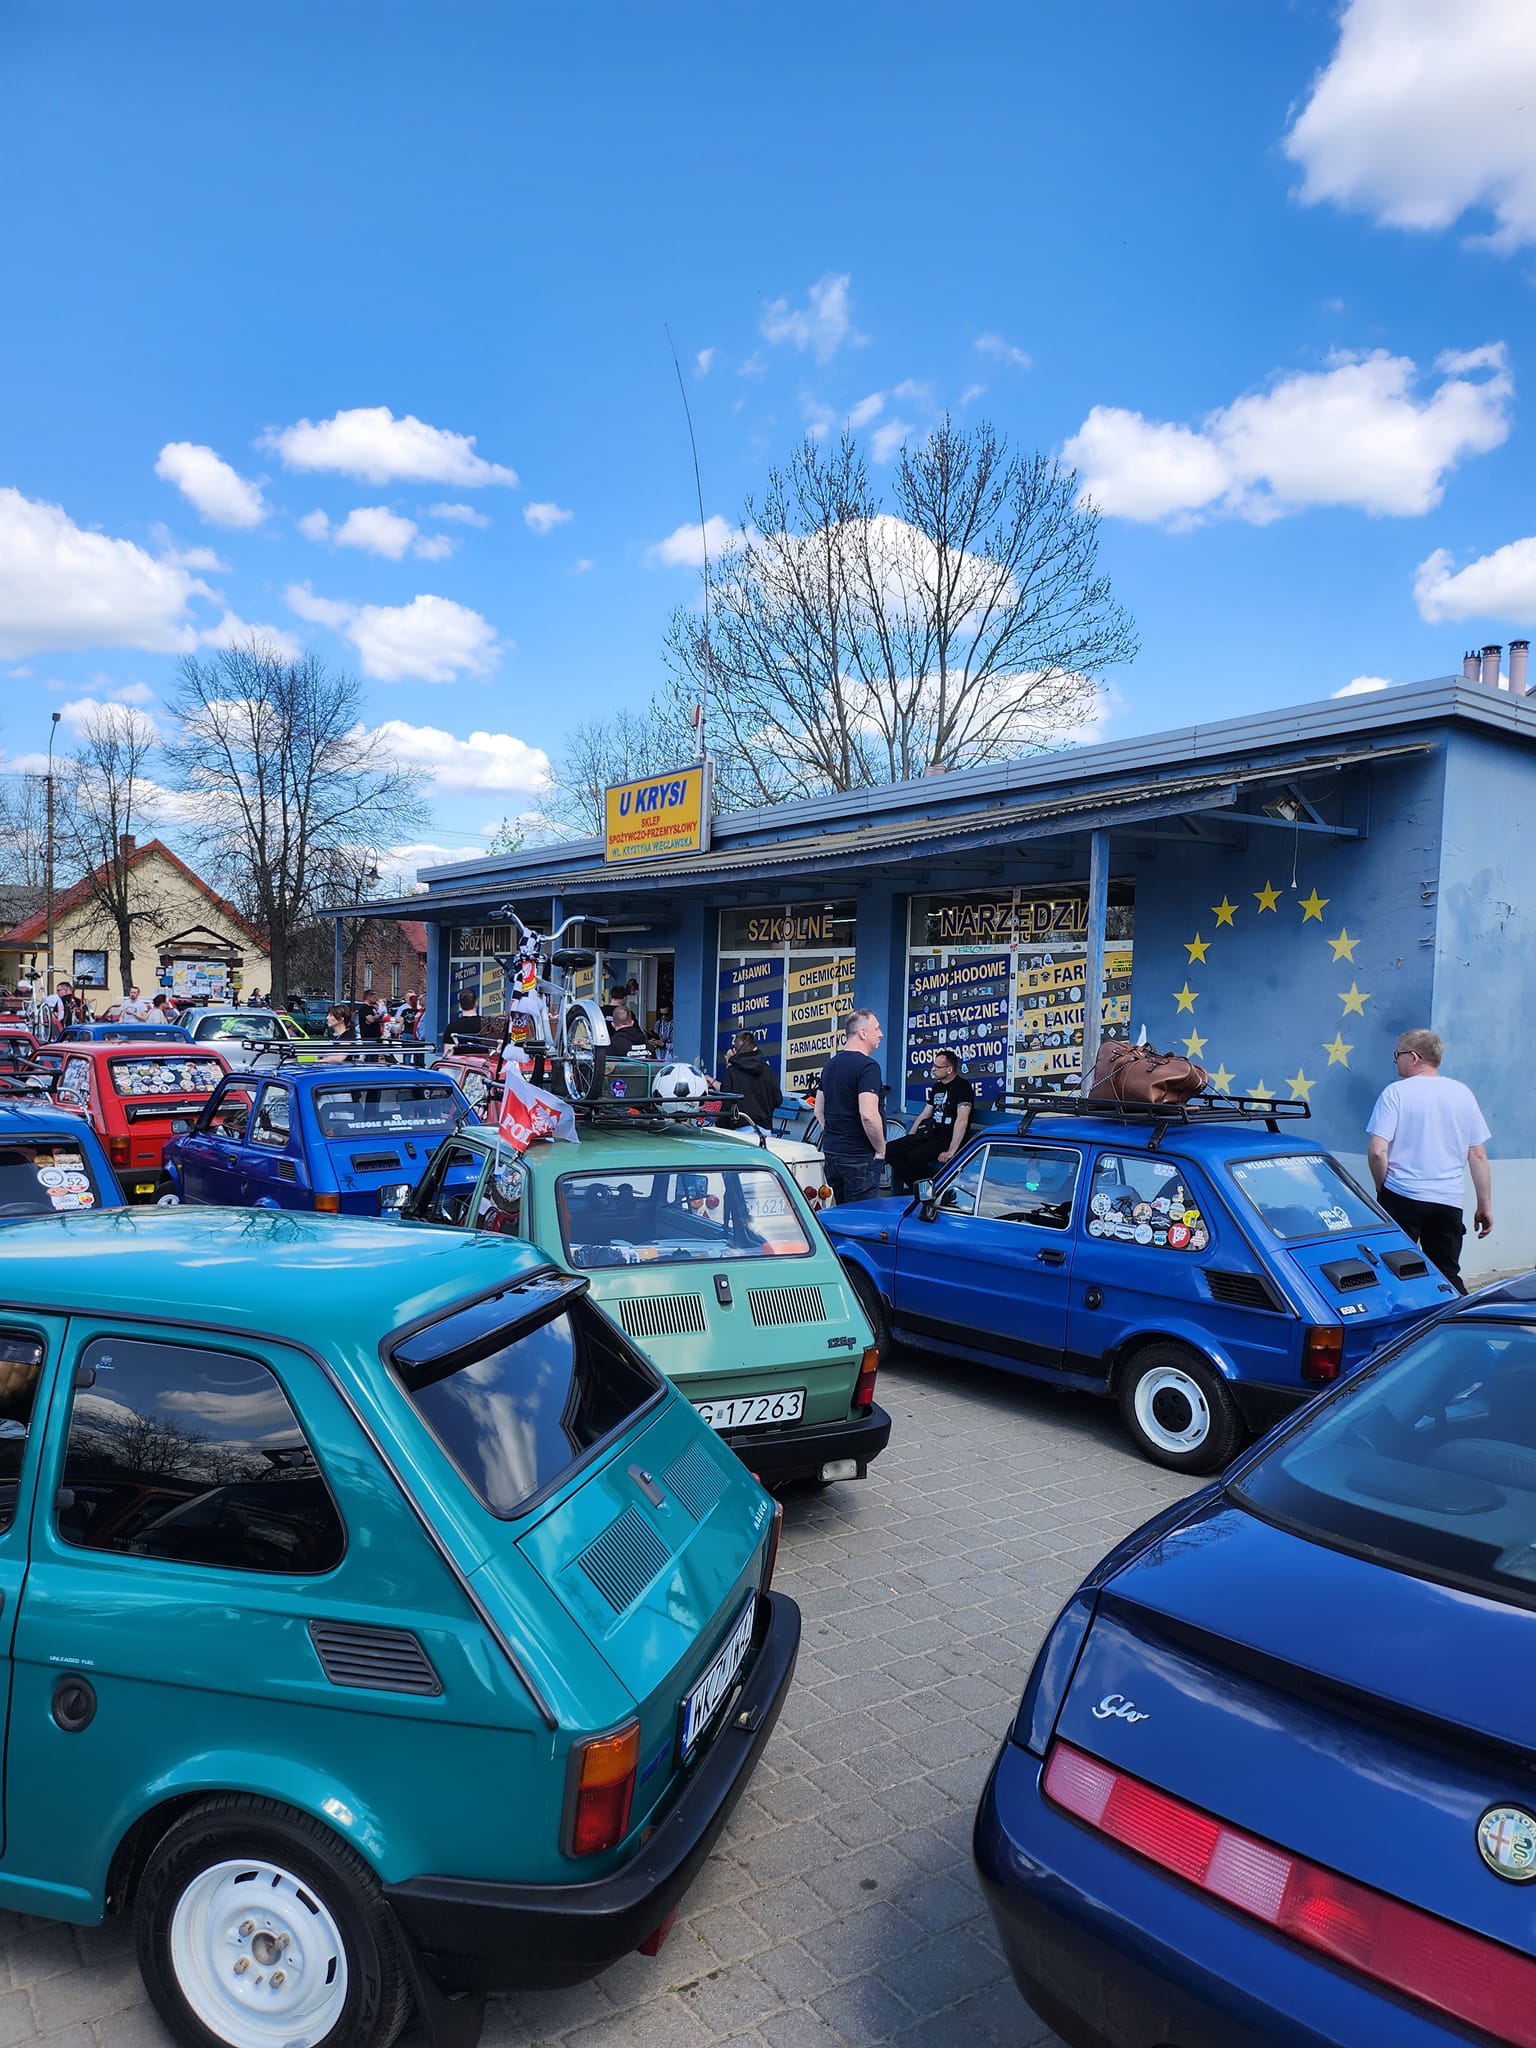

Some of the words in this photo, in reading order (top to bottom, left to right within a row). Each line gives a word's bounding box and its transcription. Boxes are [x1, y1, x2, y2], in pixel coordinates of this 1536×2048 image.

[619, 791, 632, 816] U
[635, 779, 688, 814] KRYSI
[608, 821, 698, 845] SPOŻYWCZO-PRZEMYSŁOWY
[641, 816, 661, 828] SKLEP
[748, 914, 834, 942] SZKOLNE
[732, 963, 771, 984] ZABAWKI
[799, 962, 856, 987] CHEMICZNE
[915, 960, 1006, 992] SAMOCHODOWE
[1054, 964, 1087, 984] FAR
[731, 995, 770, 1015] BIUROWE
[791, 997, 854, 1022] KOSMETYCZN
[916, 1002, 1000, 1028] ELEKTRYCZNE
[790, 1033, 848, 1055] FARMACEUTYC
[1053, 1051, 1082, 1069] KLE
[501, 1112, 533, 1146] POL
[66, 1177, 83, 1186] 52
[755, 1198, 785, 1214] 1621
[698, 1405, 713, 1424] G
[727, 1394, 801, 1425] 17263
[49, 1655, 80, 1664] UNLEADED
[1481, 1812, 1506, 1835] ALFA
